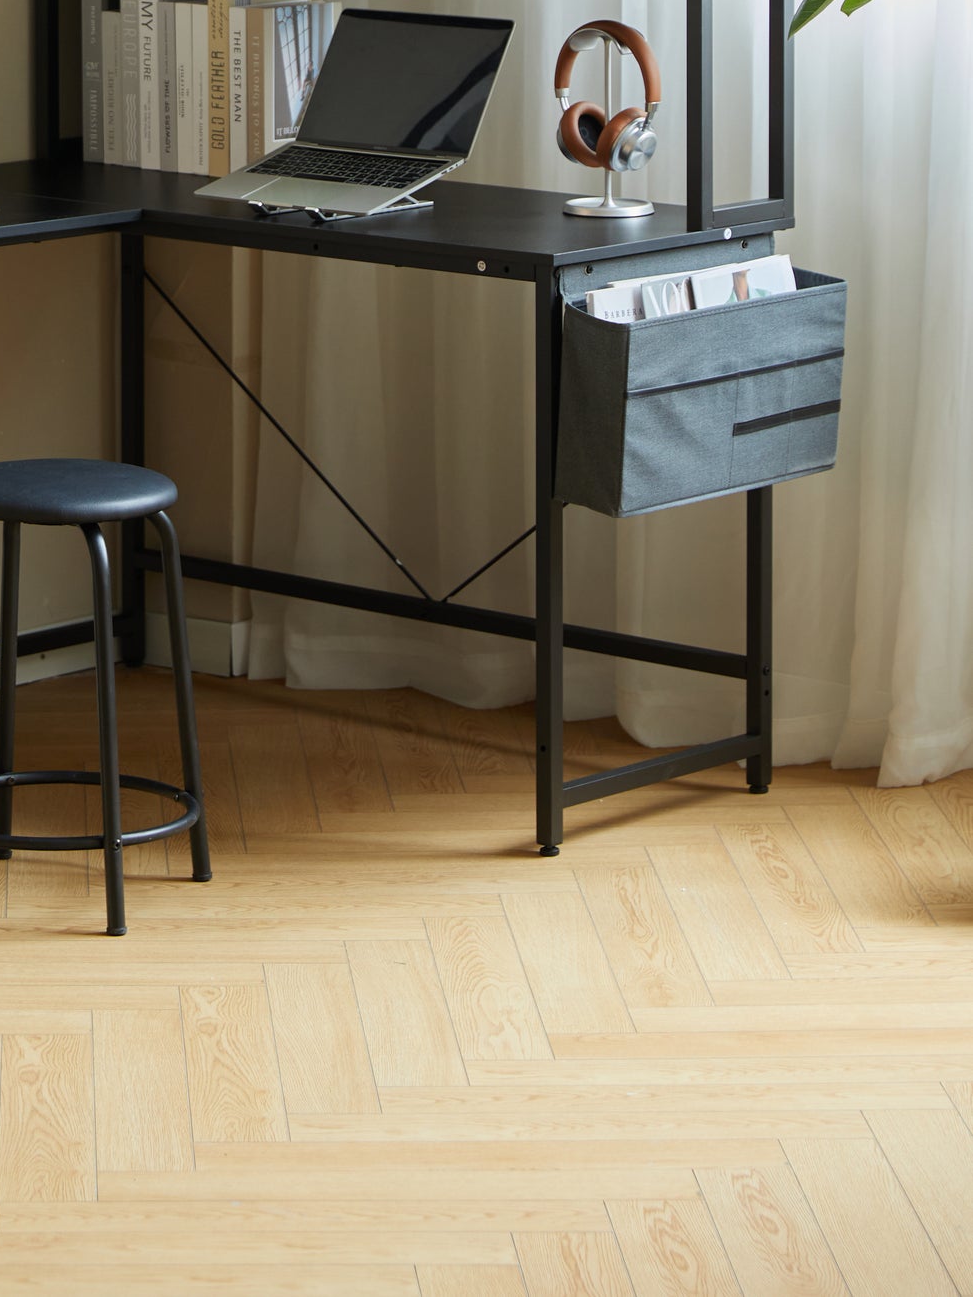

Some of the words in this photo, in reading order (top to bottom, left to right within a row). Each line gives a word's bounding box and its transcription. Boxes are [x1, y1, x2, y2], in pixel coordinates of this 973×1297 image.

[141, 1, 154, 31] MY
[123, 0, 138, 79] EUROPE
[233, 30, 242, 54] THE
[252, 35, 260, 46] IT
[143, 36, 152, 81] FUTURE
[233, 58, 242, 89] BEST
[210, 49, 226, 110] FEATHER
[252, 52, 260, 107] BELONGS
[90, 89, 98, 150] IMPOSSIBLE
[108, 109, 115, 125] NO
[164, 100, 171, 113] OF
[233, 93, 242, 123] MAN
[252, 112, 260, 127] TO
[164, 114, 172, 154] FLOWERS
[211, 116, 226, 151] GOLD
[283, 125, 301, 135] BELO
